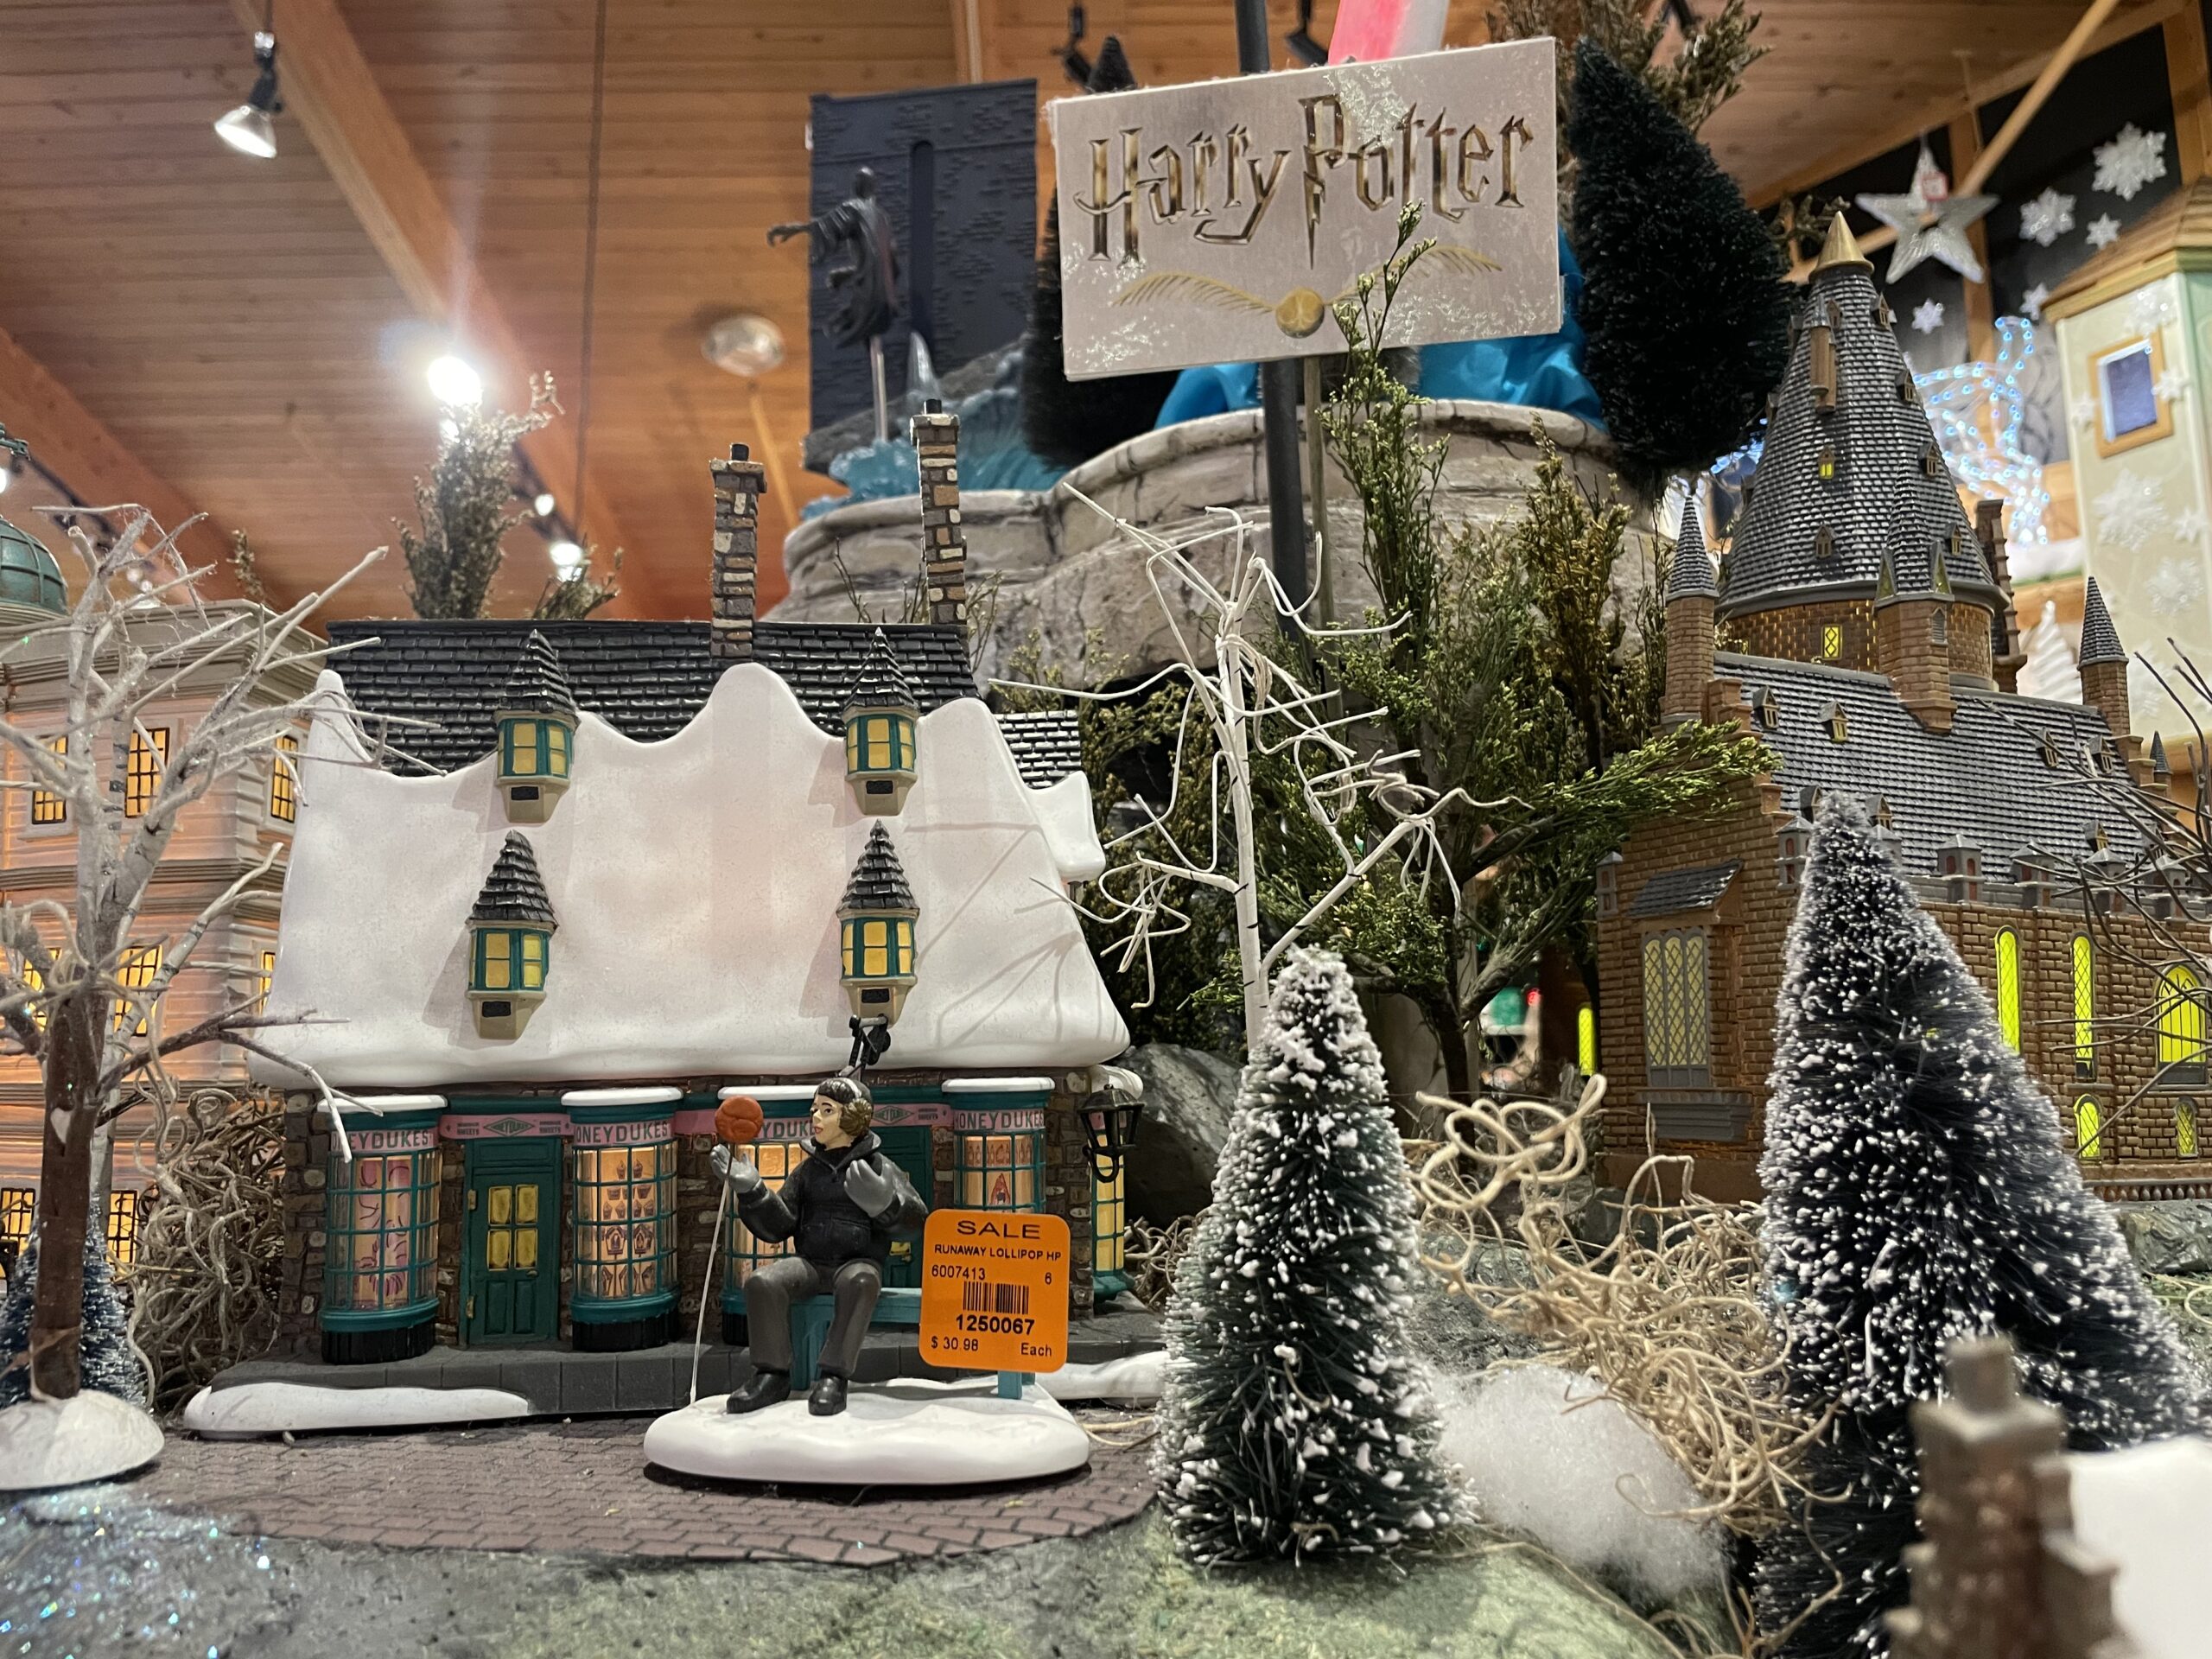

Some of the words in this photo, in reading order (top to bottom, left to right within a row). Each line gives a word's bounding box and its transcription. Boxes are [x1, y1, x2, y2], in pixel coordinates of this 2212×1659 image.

[1072, 122, 1292, 270] Harry
[1298, 92, 1534, 270] Potter
[954, 1109, 1045, 1129] HONEYDUKES
[574, 1120, 668, 1143] ONEYDUKES
[957, 1220, 1040, 1239] SALE
[934, 1244, 987, 1257] RUNAWAY
[989, 1248, 1044, 1261] LOLLIPOP
[1046, 1251, 1062, 1262] HP
[931, 1264, 986, 1281] 6007413
[1044, 1272, 1052, 1285] 6
[956, 1313, 1035, 1336] 1250067
[931, 1336, 938, 1350] $
[943, 1336, 979, 1352] 30.98
[1020, 1342, 1052, 1357] Each
